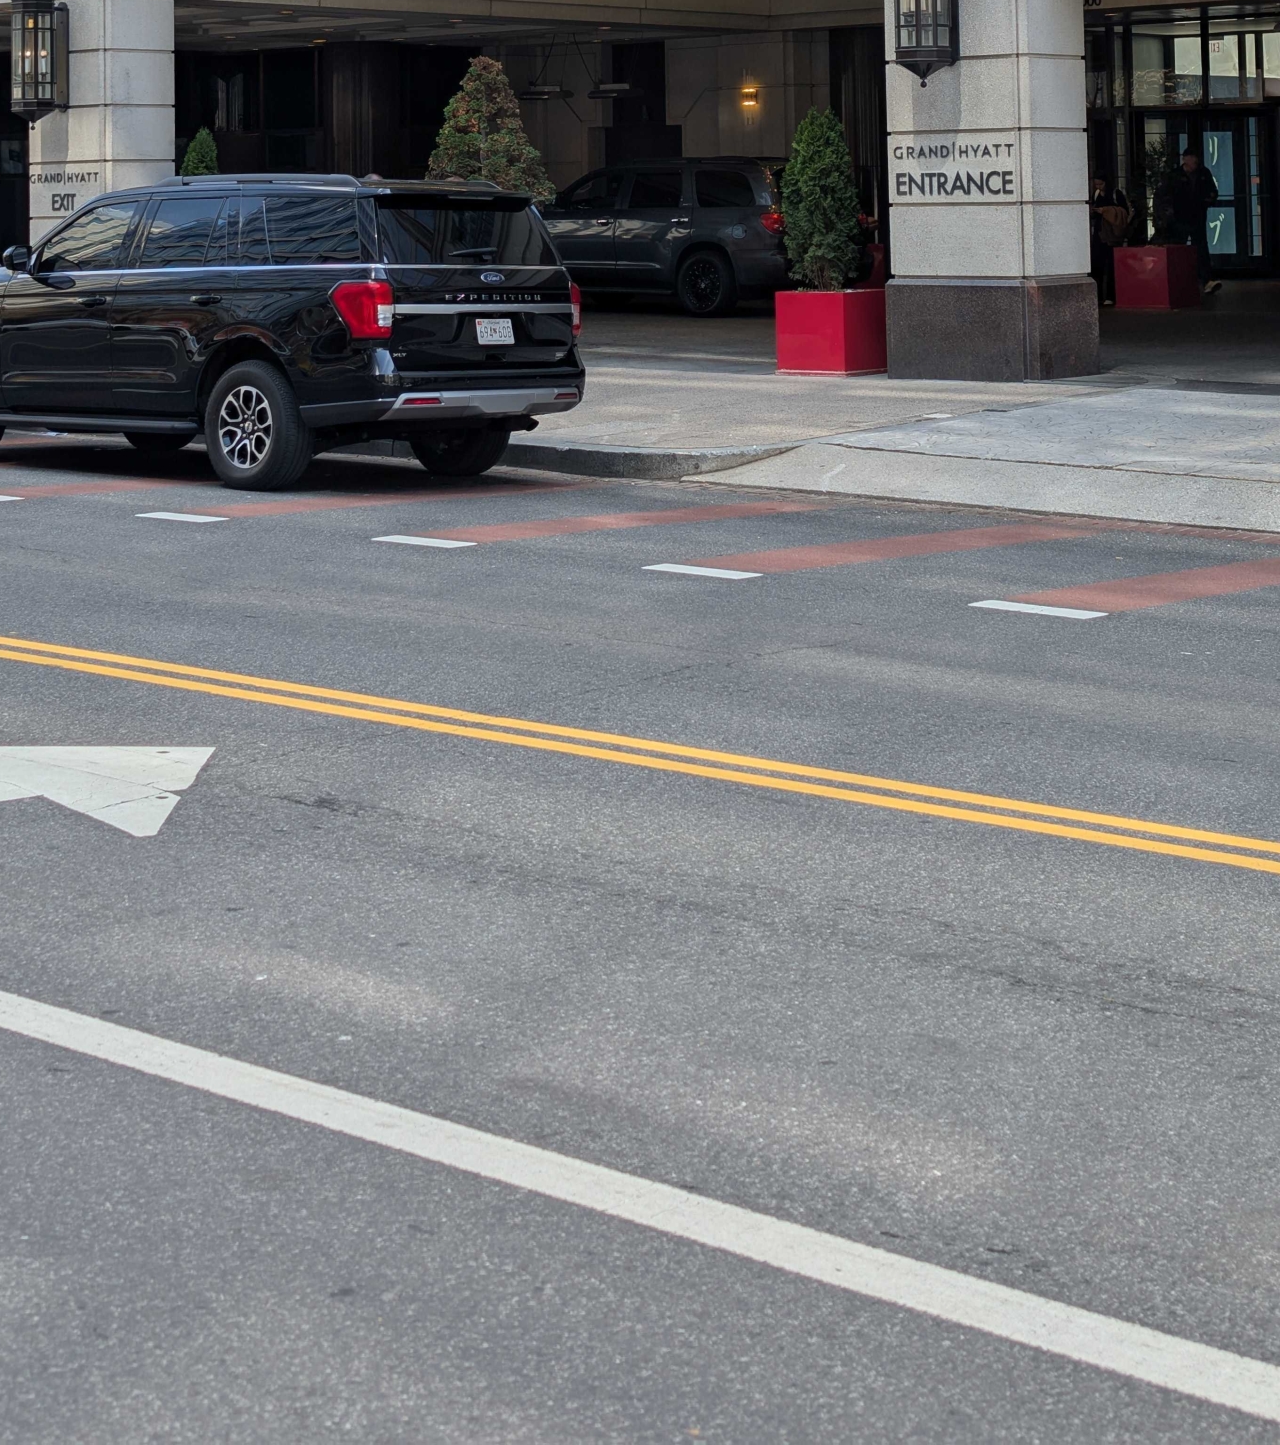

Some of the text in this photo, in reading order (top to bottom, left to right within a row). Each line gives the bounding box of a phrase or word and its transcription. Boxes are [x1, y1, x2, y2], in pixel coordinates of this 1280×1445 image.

[893, 143, 1014, 160] GRAND HYATT
[30, 172, 99, 184] GRAND HYATT
[895, 170, 1014, 196] ENTRANCE
[51, 193, 76, 211] EXIT
[445, 293, 542, 301] EXPEDITION
